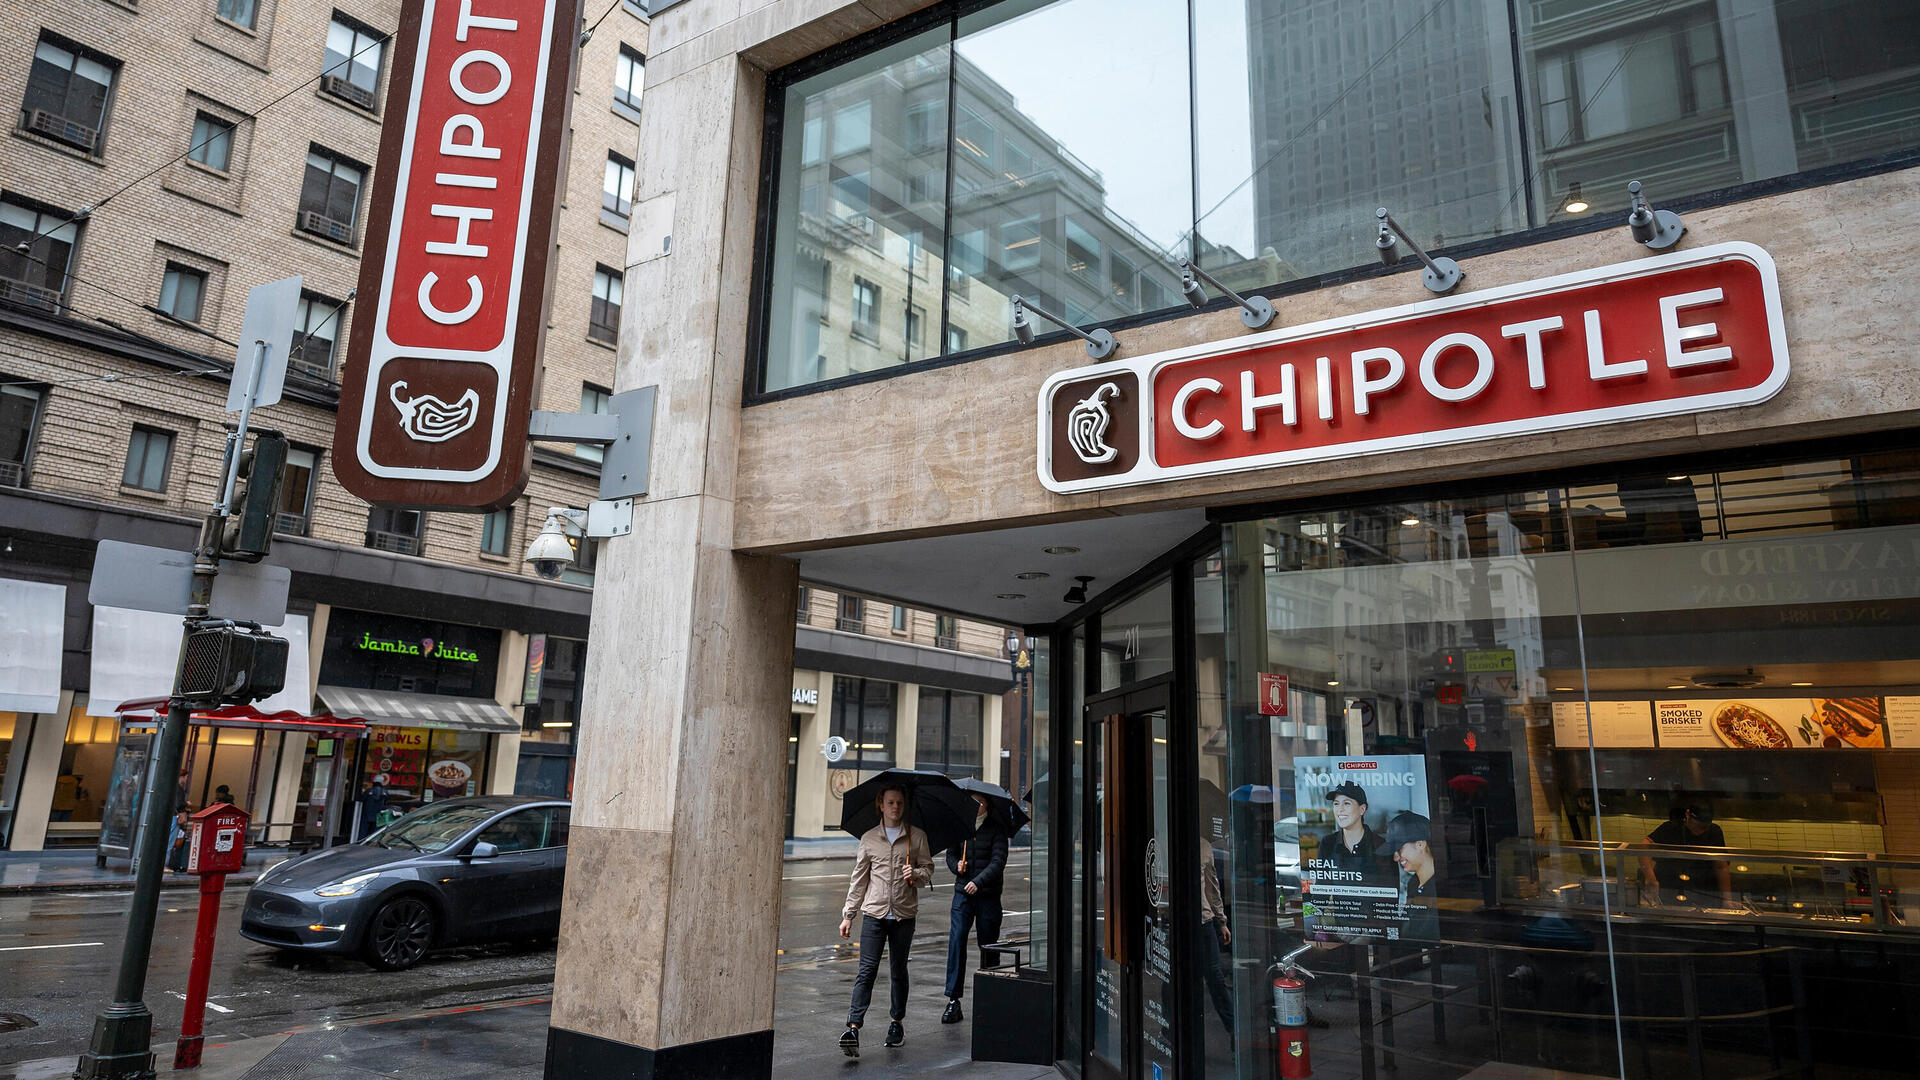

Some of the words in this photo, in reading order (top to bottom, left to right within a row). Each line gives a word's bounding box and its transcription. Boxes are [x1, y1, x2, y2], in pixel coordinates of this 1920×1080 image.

[418, 0, 519, 325] CHIPOT
[1171, 287, 1733, 441] CHIPOTLE
[1124, 624, 1140, 661] 211
[1660, 710, 1703, 718] SMOKED
[1661, 717, 1702, 725] BRISKET
[1304, 773, 1348, 787] NOW
[1353, 772, 1416, 787] HIRING
[1308, 858, 1338, 869] REAL
[1309, 870, 1363, 881] BENEFITS
